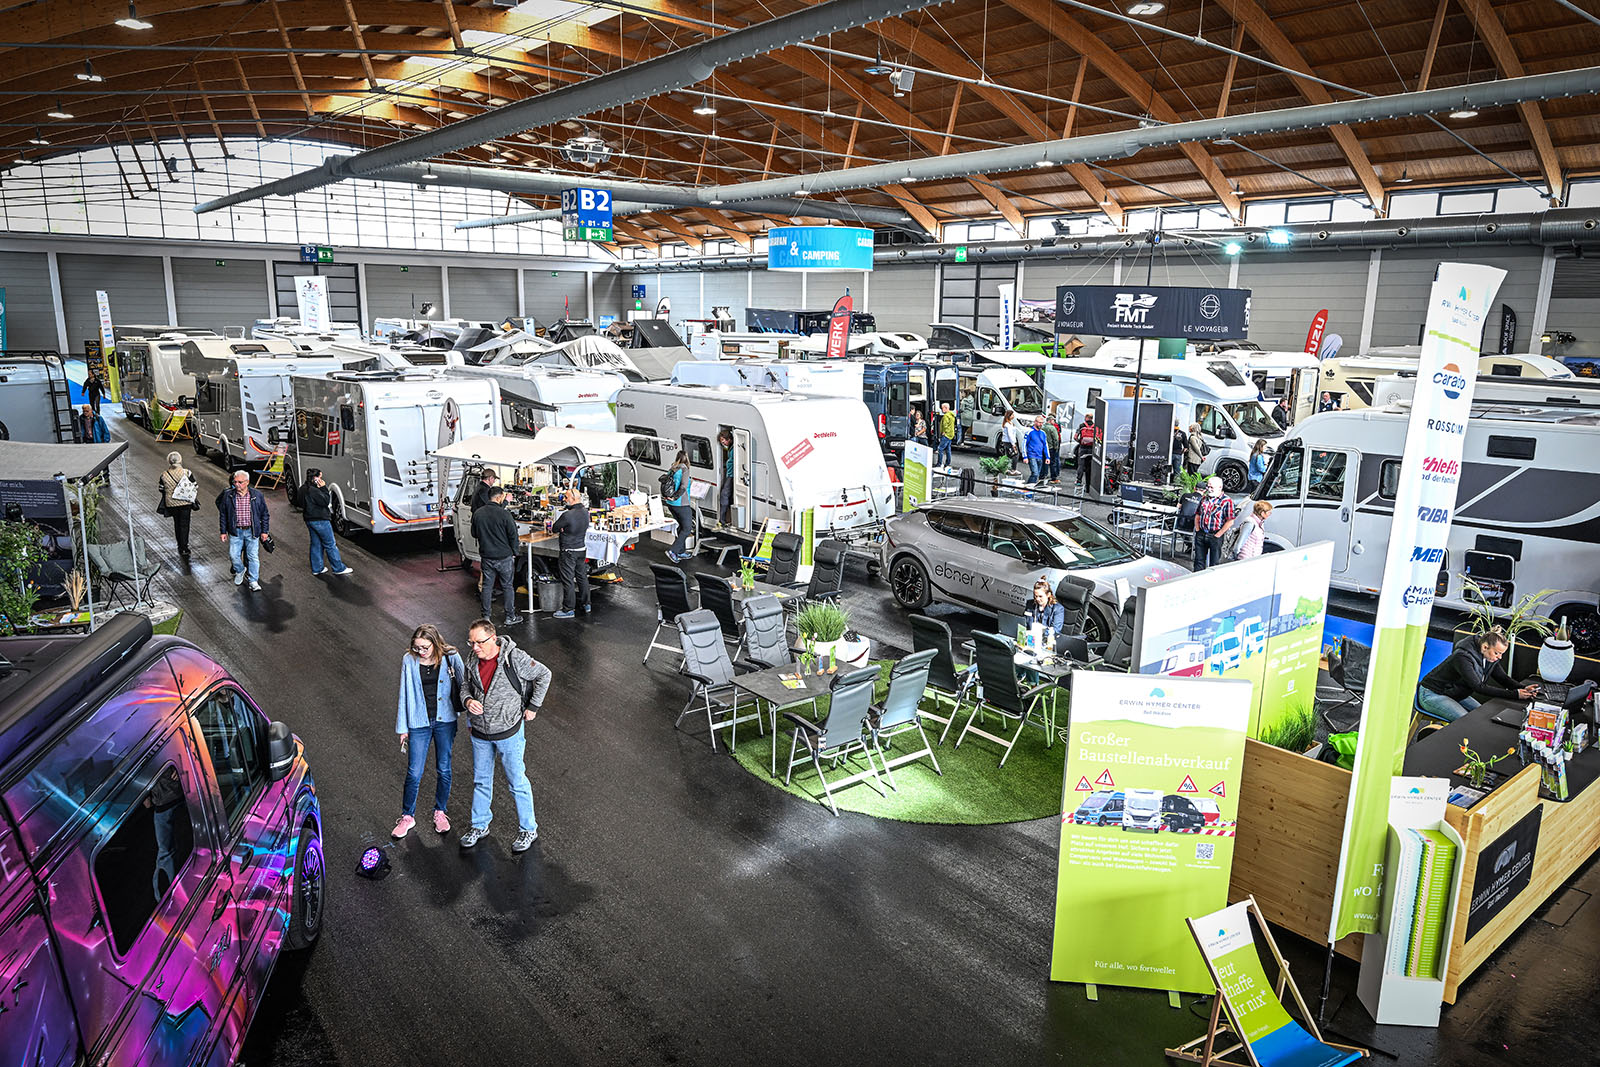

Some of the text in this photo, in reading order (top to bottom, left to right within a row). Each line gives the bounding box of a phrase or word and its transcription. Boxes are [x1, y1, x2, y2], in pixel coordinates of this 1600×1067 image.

[562, 189, 577, 211] B2
[580, 189, 609, 211] B2
[305, 246, 316, 254] B2
[790, 241, 799, 256] &
[802, 250, 839, 260] CAMPING
[1115, 308, 1149, 323] FMT
[1195, 325, 1229, 333] VOYAGEUR
[1308, 317, 1325, 356] UZU
[830, 321, 844, 357] WERK
[935, 562, 990, 592] ebner X
[1080, 732, 1131, 747] Großer
[1079, 748, 1232, 770] Baustellenabverkauf
[1471, 851, 1532, 911] ERWIN HYMER CENTER
[1354, 887, 1372, 897] wo
[1094, 960, 1108, 969] Für
[1109, 962, 1125, 970] alle,
[1139, 964, 1176, 975] fortwellet
[1215, 961, 1237, 980] eut
[1224, 974, 1255, 999] chaffe
[1233, 1001, 1247, 1019] ir
